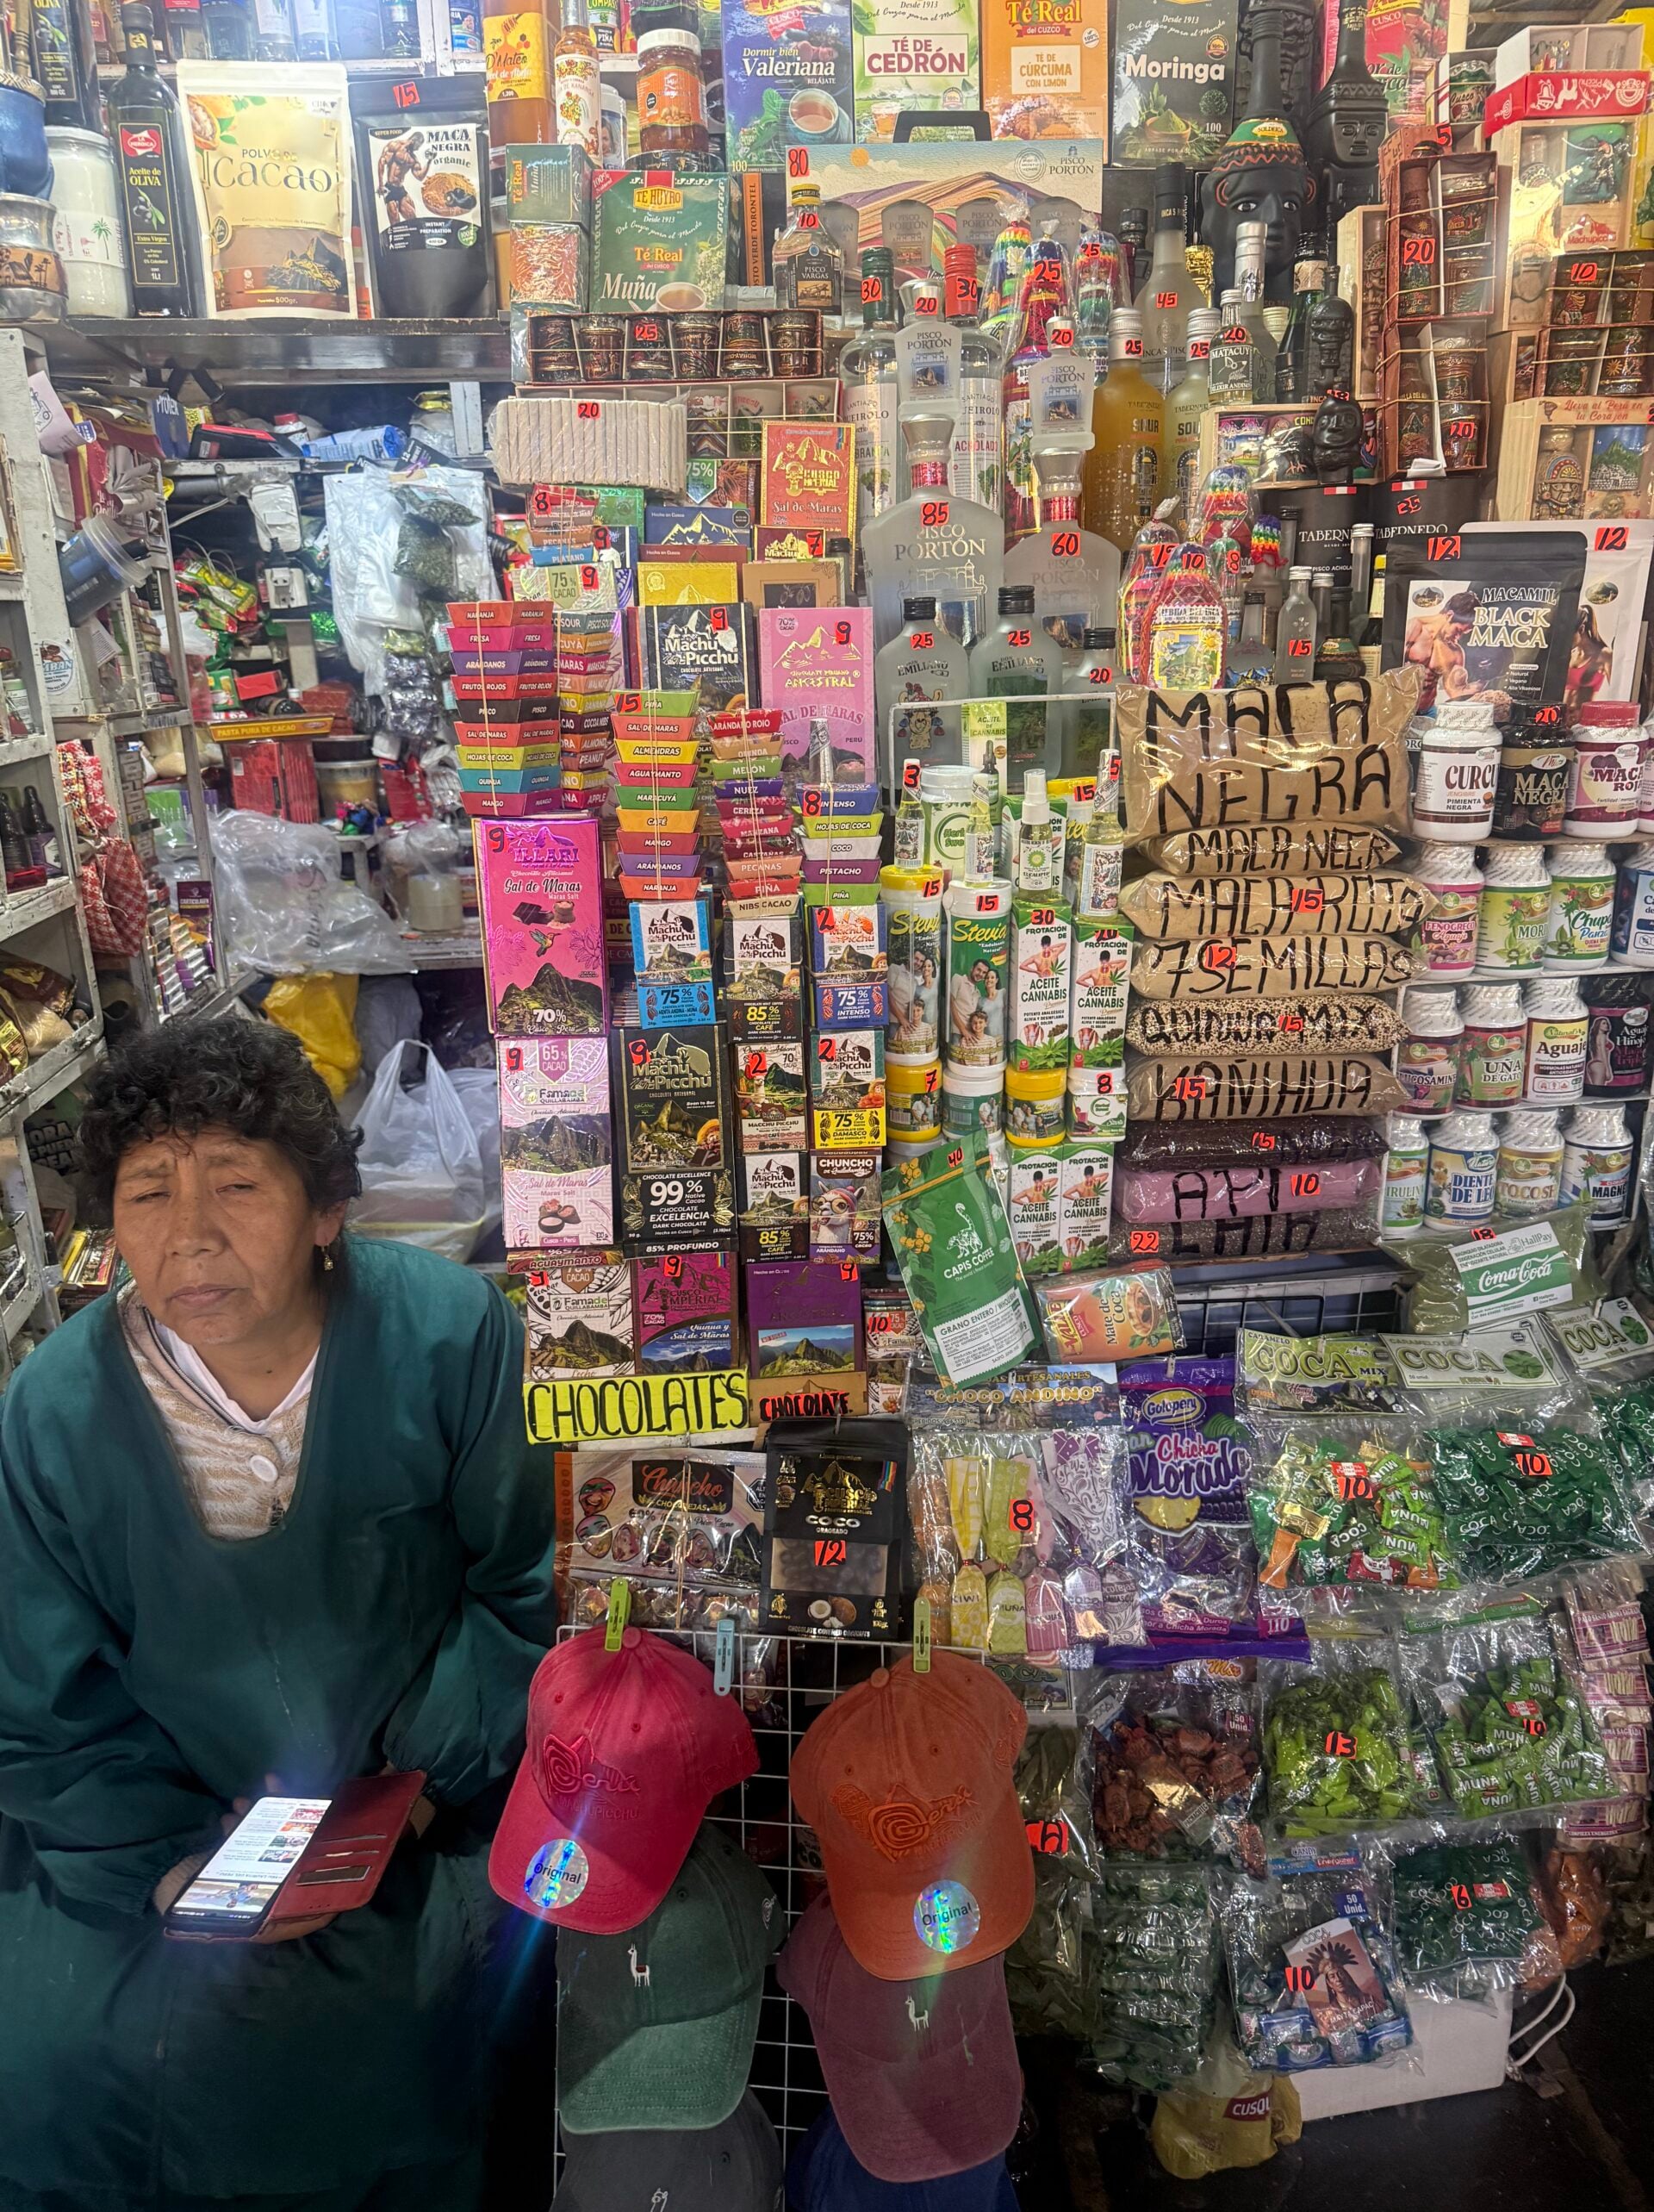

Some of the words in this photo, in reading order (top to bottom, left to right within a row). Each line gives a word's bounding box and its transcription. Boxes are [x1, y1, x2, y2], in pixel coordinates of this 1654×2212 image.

[768, 9, 800, 25] CUSCO
[1162, 14, 1179, 24] Desde
[1181, 16, 1199, 24] 1913
[743, 47, 775, 58] Dormir
[779, 47, 799, 57] bien
[892, 37, 911, 53] TÉ
[914, 39, 933, 53] DE
[743, 56, 836, 78] Valeriana
[867, 47, 966, 74] CEDRÓN
[1125, 54, 1225, 83] Moringa
[1019, 62, 1073, 78] CÚRCUMA
[1026, 78, 1042, 88] CON
[1042, 77, 1067, 88] LIMÓN
[433, 156, 470, 167] organic
[788, 149, 809, 175] 80
[1048, 162, 1095, 175] PORTÓN
[1060, 156, 1085, 165] PISCO
[129, 167, 147, 177] Aceite
[214, 156, 333, 193] Cacao
[130, 176, 161, 186] OLIVA
[800, 214, 817, 227] 10
[635, 247, 654, 262] Té
[656, 248, 682, 263] Real
[1405, 240, 1433, 263] 20
[801, 271, 829, 280] VARGAS
[1035, 261, 1061, 282] 25
[1572, 264, 1595, 280] 10
[600, 272, 656, 301] Muña
[862, 281, 880, 302] 30
[916, 297, 937, 313] 20
[636, 324, 656, 340] 25
[917, 331, 942, 340] PISCO
[906, 337, 953, 349] PORTÓN
[1125, 340, 1142, 355] 25
[579, 403, 599, 419] 20
[534, 491, 550, 510] 8
[923, 502, 948, 524] 85
[1053, 534, 1079, 556] 60
[1597, 528, 1626, 550] 12
[1429, 536, 1458, 560] 12
[1185, 553, 1203, 569] 10
[712, 608, 726, 630] 9
[1473, 607, 1551, 627] BLACK
[836, 620, 851, 645] 9
[1009, 630, 1030, 645] 25
[1468, 626, 1548, 648] MACA
[665, 636, 718, 653] Machu
[911, 634, 933, 648] 25
[685, 647, 739, 666] Picchu
[616, 694, 639, 712] 15
[1146, 677, 1373, 766] MACA
[732, 765, 766, 775] MELÓN
[734, 786, 759, 794] NUEZ
[1158, 745, 1391, 834] NEGRA
[637, 794, 677, 802] MARACUYÁ
[805, 791, 820, 815] 8
[488, 829, 506, 851] 9
[503, 877, 522, 894] Sal
[525, 878, 539, 892] de
[542, 879, 581, 893] Maras
[762, 900, 792, 908] CACAO
[977, 896, 998, 910] 15
[1161, 875, 1294, 938] MACA
[1307, 875, 1423, 934] ROJA
[1293, 890, 1321, 912] 15
[818, 910, 834, 930] 2
[1031, 910, 1054, 925] 30
[648, 924, 683, 936] Machu
[662, 931, 695, 943] Picchu
[951, 919, 1006, 943] Stevia
[1026, 925, 1067, 935] FROTACIÓN
[1152, 940, 1191, 999] 7
[1190, 936, 1415, 994] SEMILLAS
[1029, 977, 1060, 989] ACEITE
[532, 1007, 567, 1023] 70%
[746, 1006, 780, 1020] 85%
[837, 1008, 870, 1017] INTENSO
[1536, 1039, 1587, 1057] Aguaje
[506, 1050, 522, 1069] 9
[542, 1060, 567, 1071] CACAO
[1483, 1060, 1521, 1074] UÑA
[632, 1062, 690, 1077] Machu
[655, 1074, 712, 1089] Picchu
[1097, 1074, 1112, 1094] 8
[819, 1158, 874, 1168] CHUNCHO
[1291, 1174, 1320, 1195] 10
[1452, 1173, 1494, 1187] DIENTE
[650, 1179, 703, 1206] 99%
[1172, 1168, 1281, 1220] API
[1022, 1203, 1049, 1213] ACEITE
[650, 1212, 710, 1222] EXCELENCIA
[1013, 1212, 1057, 1224] CANNABIS
[646, 1243, 664, 1253] 85%
[667, 1241, 719, 1251] PROFUNDO
[1132, 1231, 1157, 1251] 22
[529, 1256, 602, 1269] AGUAYMANTO
[943, 1260, 972, 1279] CAPIS
[972, 1248, 995, 1268] COFFEE
[563, 1296, 608, 1306] Famade
[869, 1315, 890, 1331] 10
[670, 1331, 686, 1340] Sal
[701, 1330, 731, 1339] Maras
[1247, 1331, 1291, 1345] CARAMELO
[1563, 1319, 1627, 1355] COCA
[1249, 1346, 1357, 1380] COCA
[1359, 1367, 1388, 1376] MIX
[1395, 1347, 1507, 1374] COCA
[528, 1371, 747, 1442] CHOCOLATES
[1146, 1396, 1198, 1417] Golopery
[1157, 1432, 1218, 1463] Chicha
[1519, 1454, 1551, 1475] 10
[1341, 1476, 1371, 1499] 10
[805, 1515, 861, 1529] COCO
[1012, 1500, 1033, 1530] 8
[817, 1541, 844, 1565] 12
[1328, 1732, 1359, 1756] 13
[532, 1861, 581, 1885] Original
[1346, 1894, 1358, 1903] 50
[1456, 1885, 1470, 1907] 6
[921, 1901, 973, 1928] Original
[1344, 1903, 1365, 1914] Unid.
[1291, 1966, 1315, 1991] 10
